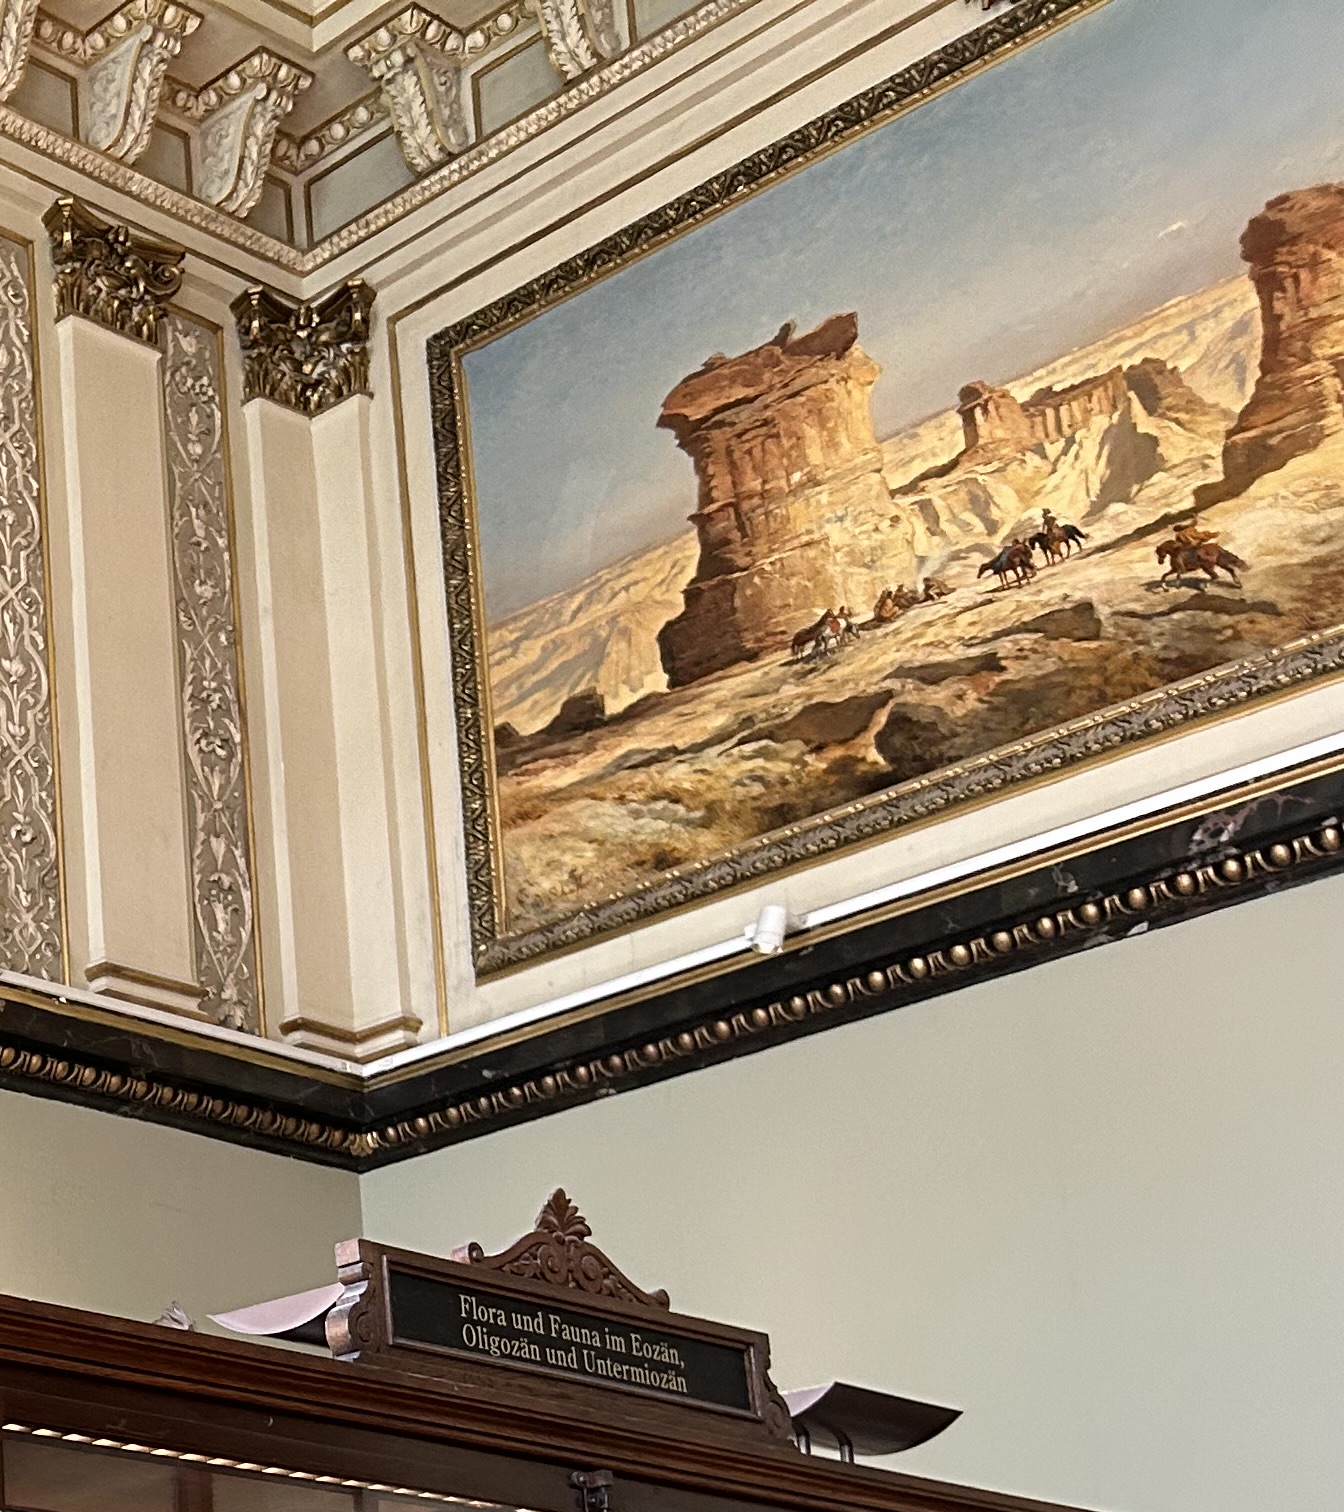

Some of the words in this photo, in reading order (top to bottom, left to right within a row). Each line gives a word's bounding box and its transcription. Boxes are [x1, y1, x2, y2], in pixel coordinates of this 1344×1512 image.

[458, 1294, 506, 1326] Flora
[512, 1311, 545, 1335] und
[548, 1314, 601, 1348] Fauna
[605, 1328, 626, 1353] im
[630, 1333, 686, 1368] Eozän,
[462, 1324, 541, 1362] Oligozän
[546, 1346, 578, 1370] und
[582, 1349, 688, 1393] Untermiozän
